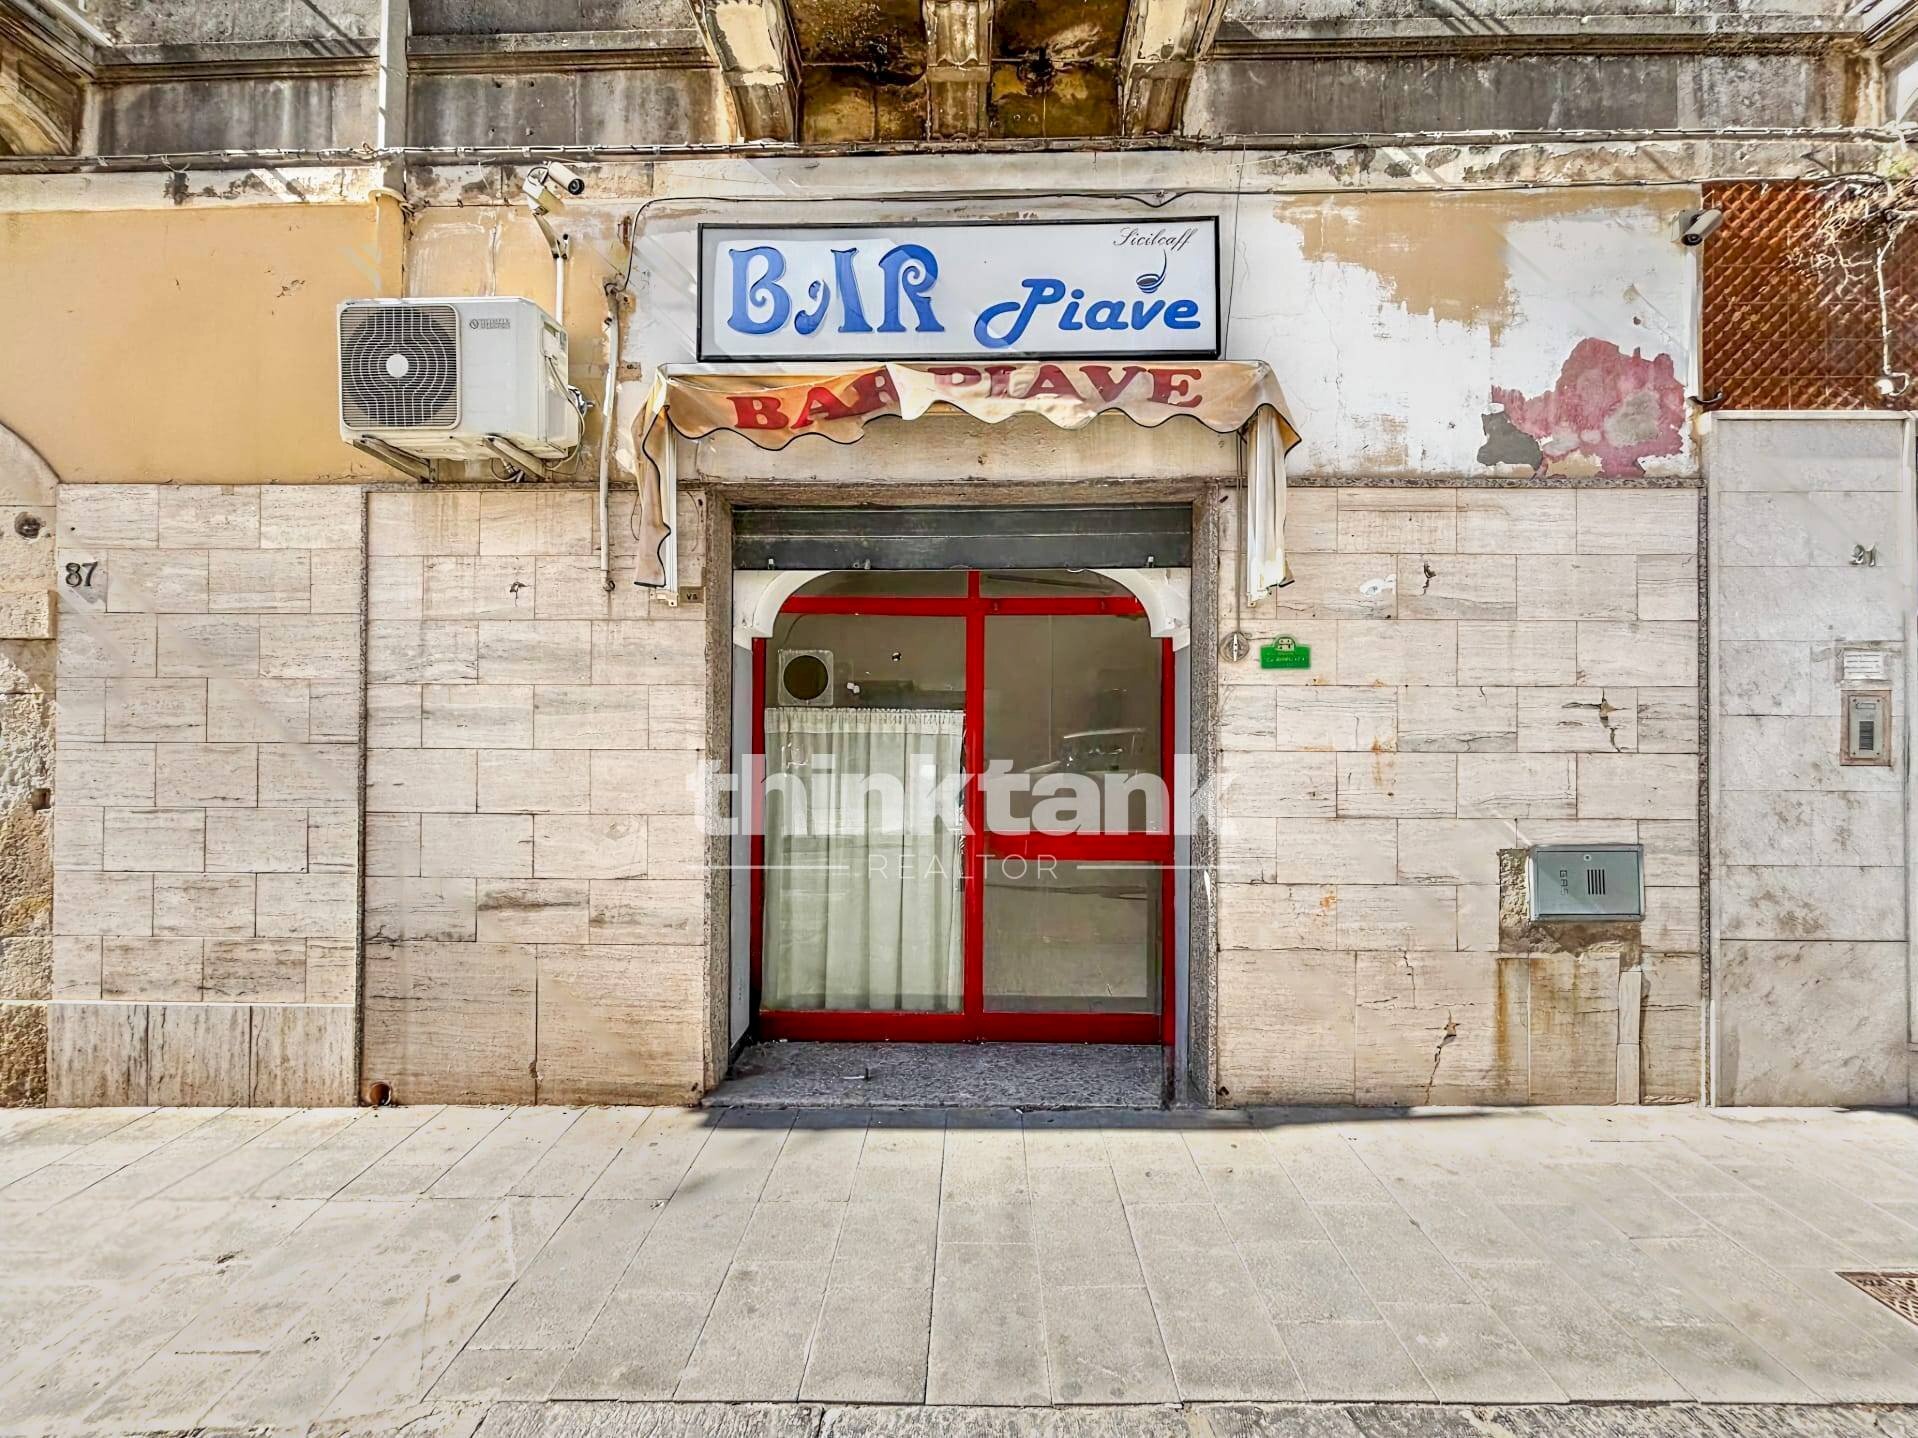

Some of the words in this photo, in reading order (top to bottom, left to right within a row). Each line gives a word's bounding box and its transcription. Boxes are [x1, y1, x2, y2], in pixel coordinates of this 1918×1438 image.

[727, 243, 945, 335] BAR
[973, 278, 1200, 349] Piave
[927, 364, 1203, 408] PIAVE
[65, 561, 98, 588] 87
[1560, 869, 1569, 896] GAS
